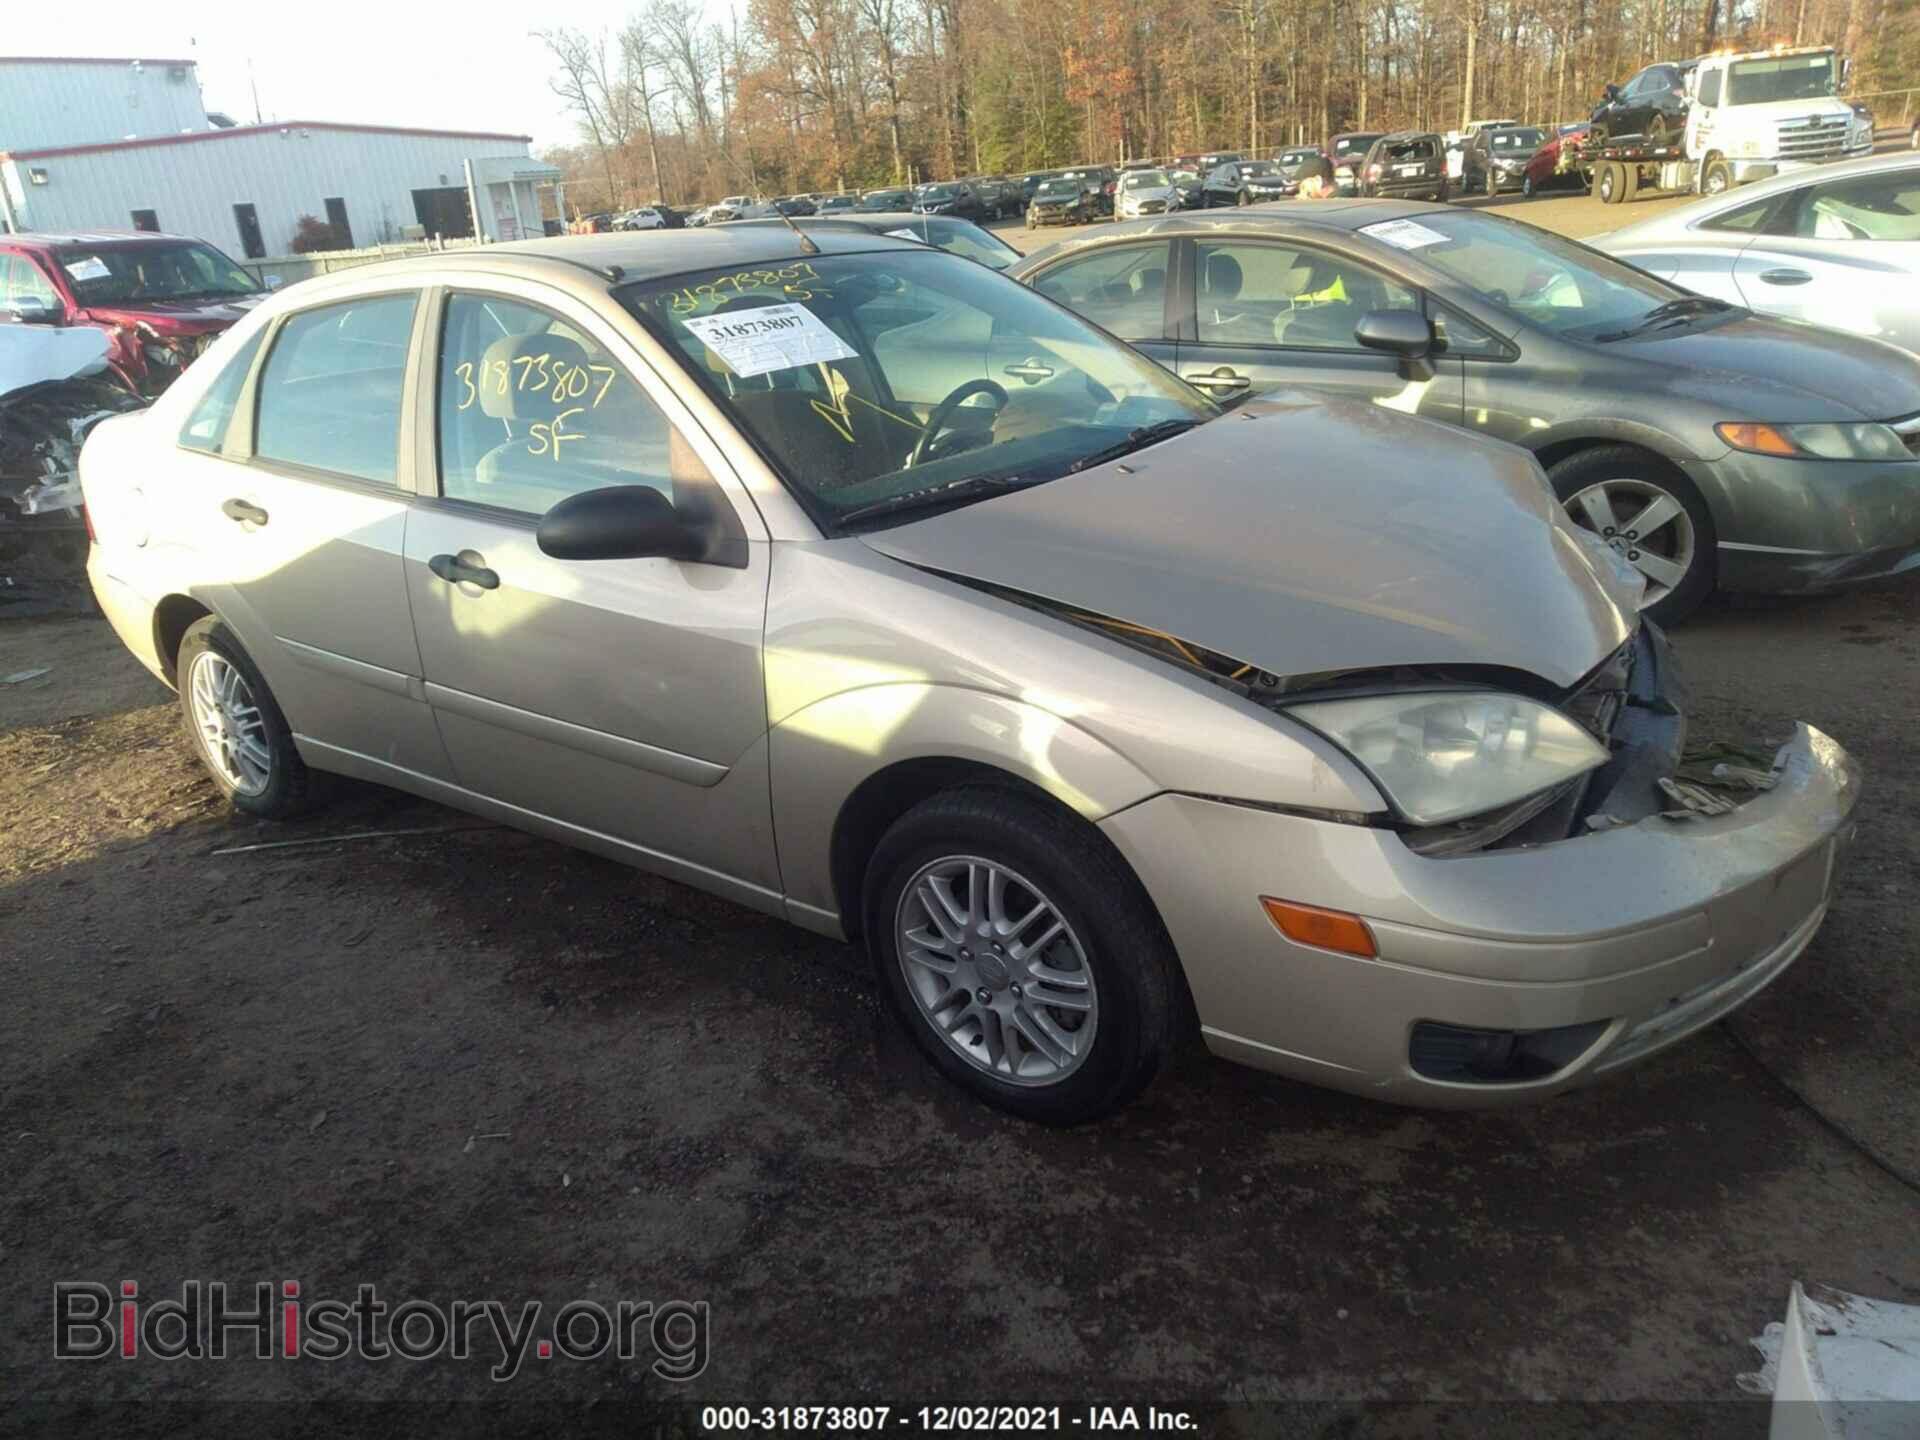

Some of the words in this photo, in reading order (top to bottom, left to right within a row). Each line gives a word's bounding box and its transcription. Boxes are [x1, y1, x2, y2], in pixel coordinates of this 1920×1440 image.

[707, 315, 804, 342] 31873807
[455, 353, 616, 410] 31873807
[527, 407, 587, 462] SF
